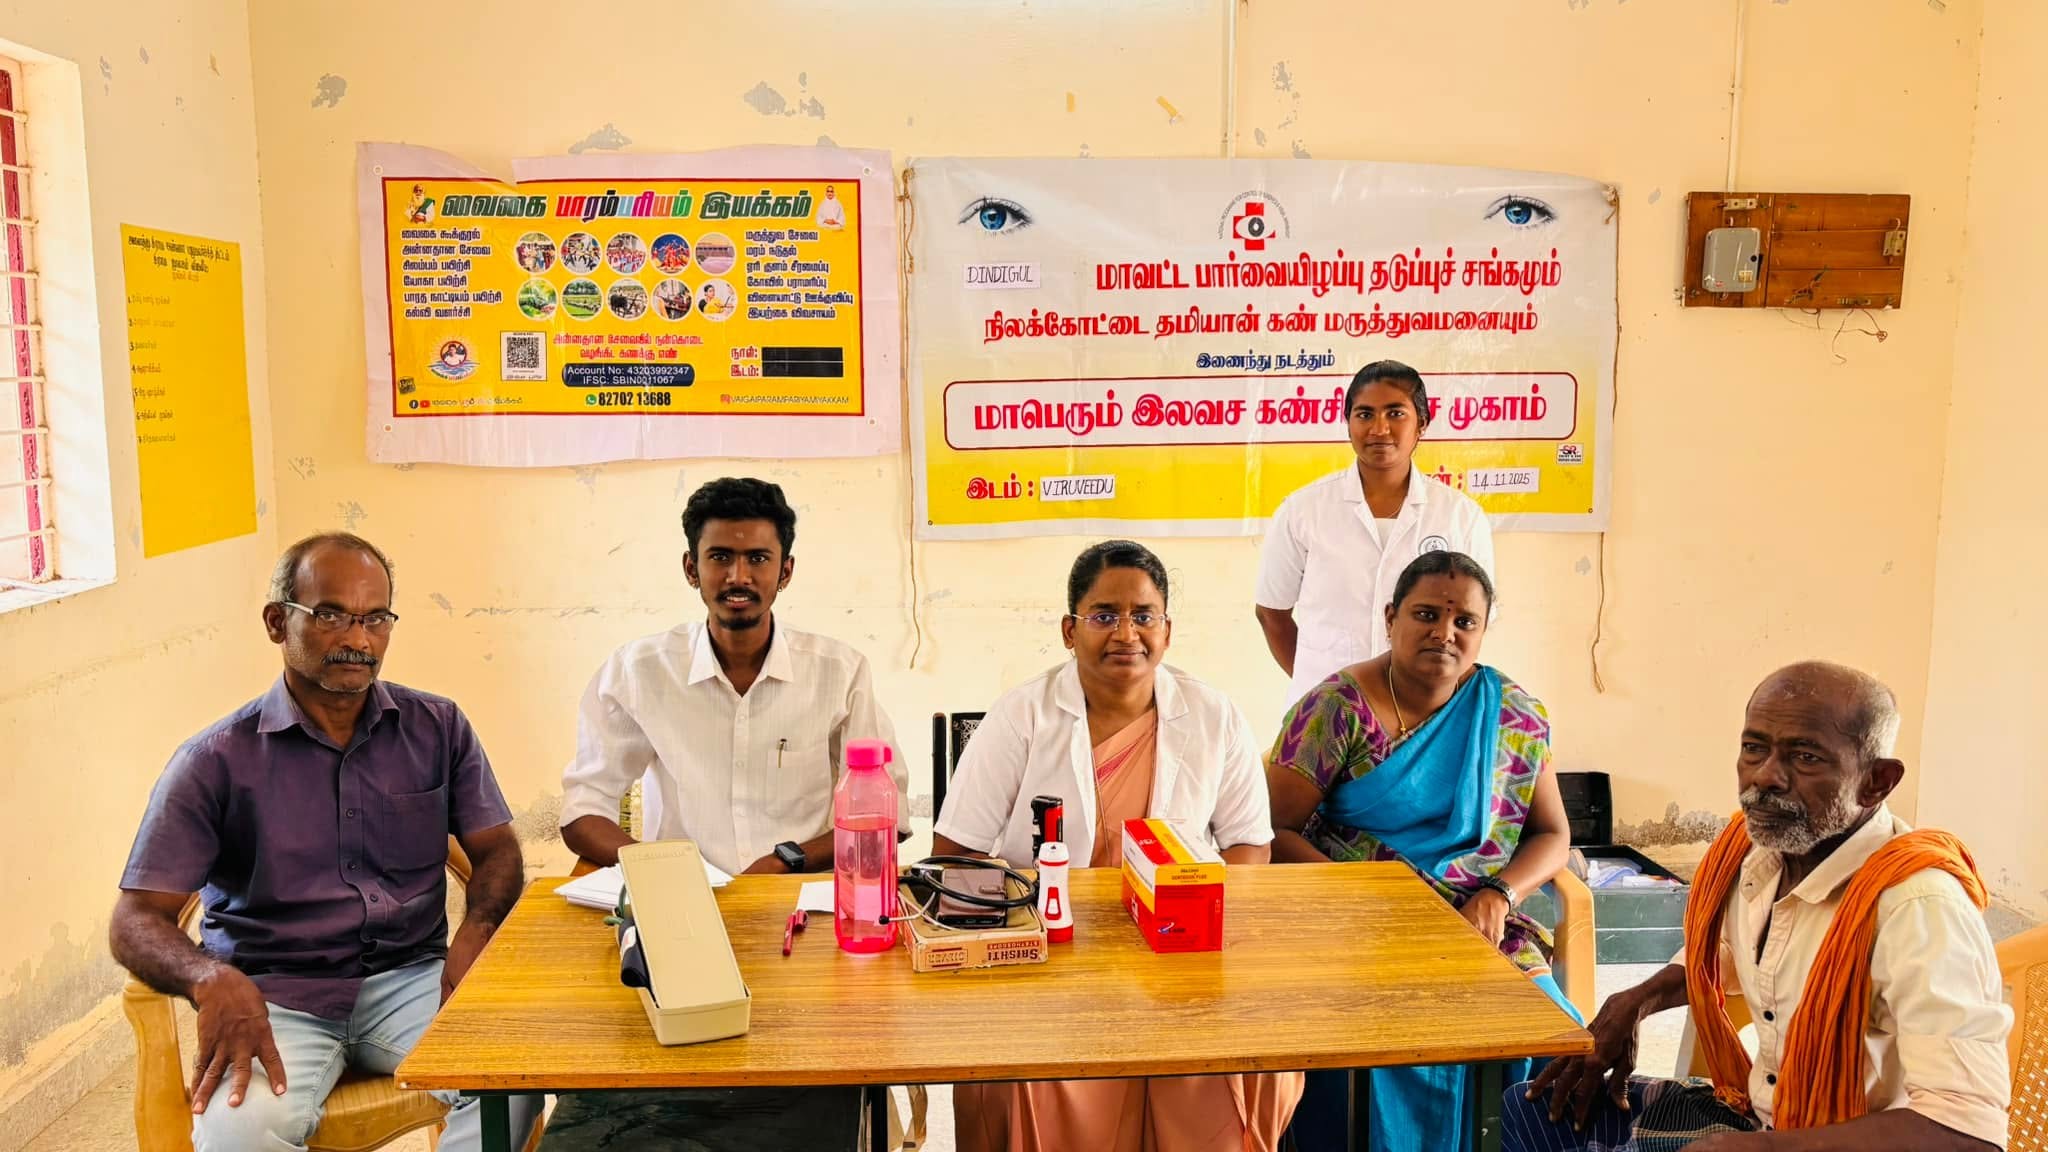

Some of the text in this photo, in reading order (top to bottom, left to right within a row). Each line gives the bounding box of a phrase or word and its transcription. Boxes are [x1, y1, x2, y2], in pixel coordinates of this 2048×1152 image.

[441, 189, 812, 222] வைகை பாரம்பரியம் இயக்கம்
[402, 230, 436, 239] வைகை
[788, 229, 818, 240] சேவை
[402, 243, 491, 256] அன்னதான சேவை
[403, 259, 438, 270] சிலம்பம்
[1096, 247, 1562, 297] மாவட்ட பார்வையிழப்பு தடுப்புச் சங்கமும்
[967, 265, 1033, 284] DINDIGUL
[984, 303, 1538, 344] நிலக்கோட்டை தமியான் கண் மருத்துவமனையும்
[1196, 348, 1335, 371] இணைந்து நடத்தும்
[567, 366, 690, 375] Account No: 43203992347
[583, 376, 610, 385] IFSC:
[598, 392, 634, 406] 82702
[974, 389, 1123, 436] மாபெரும்
[1132, 393, 1247, 427] இலவச
[1450, 384, 1547, 430] முகாம்
[966, 473, 1022, 499] இடம்
[1043, 478, 1114, 496] VIRUVEEDU
